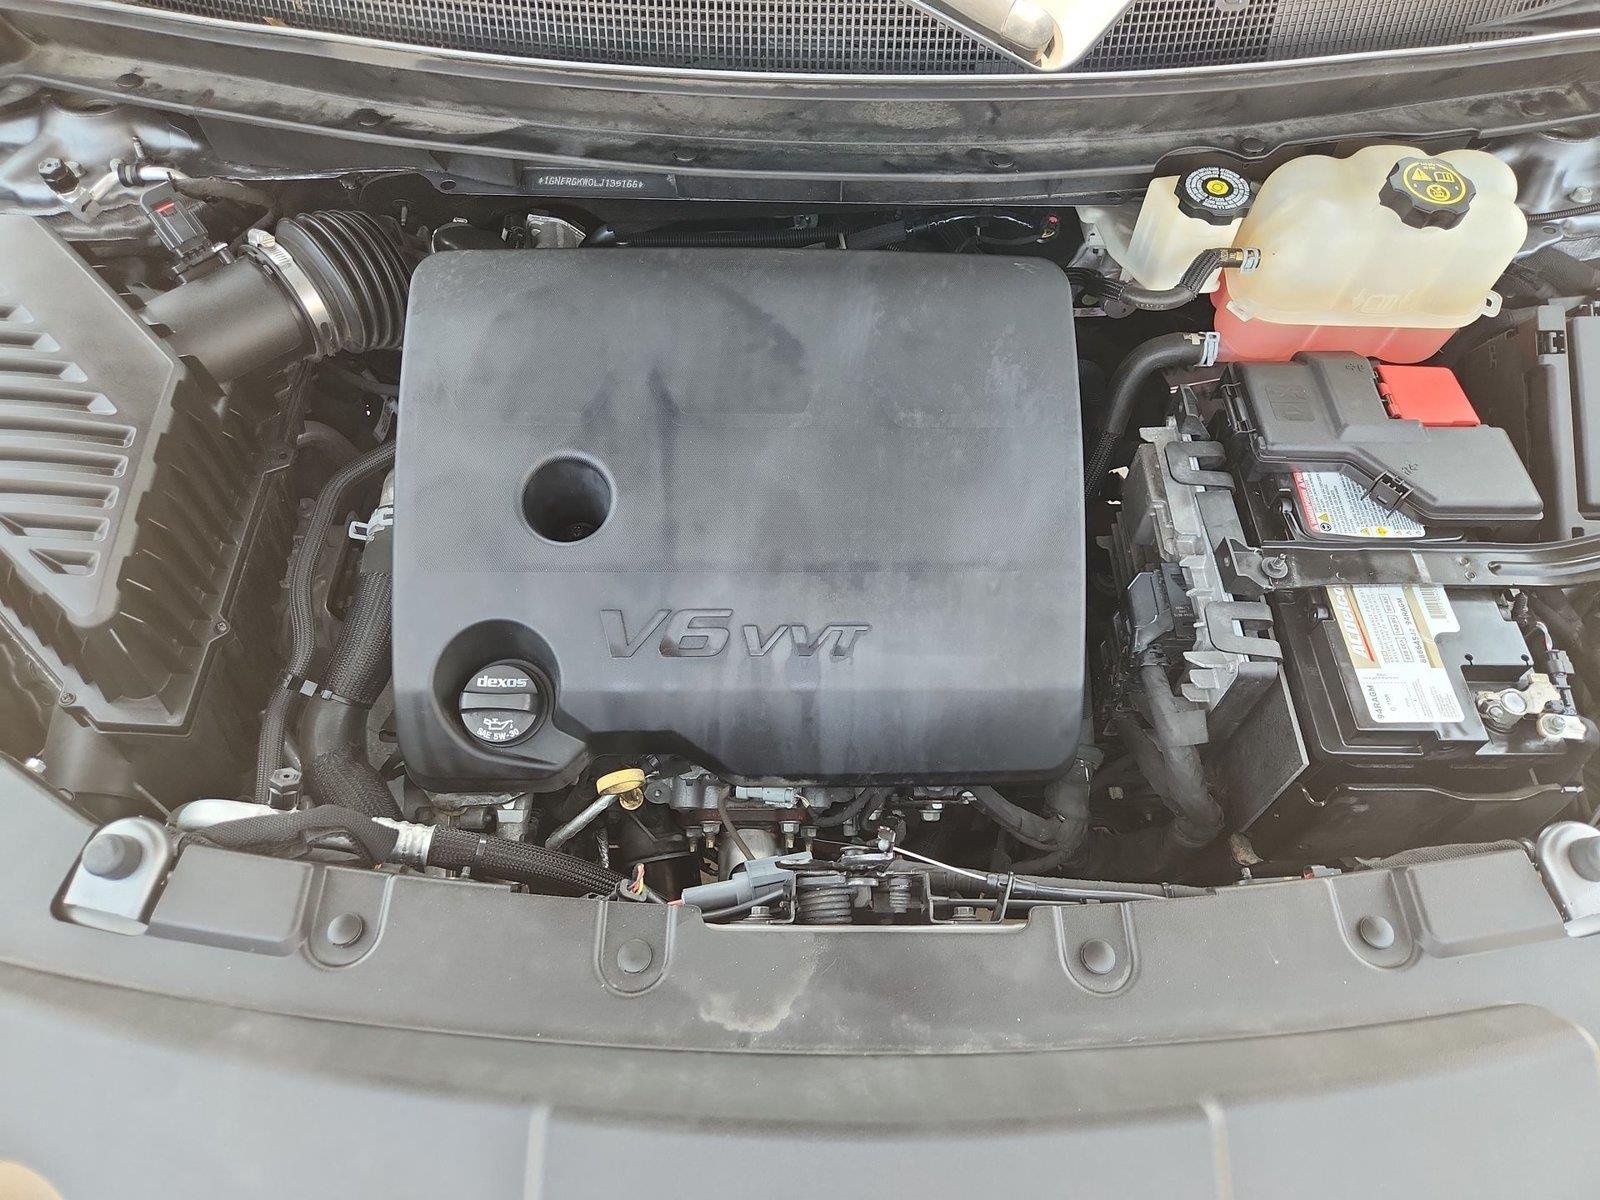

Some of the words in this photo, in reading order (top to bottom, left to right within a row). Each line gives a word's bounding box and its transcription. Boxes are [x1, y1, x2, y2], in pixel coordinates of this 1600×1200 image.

[600, 608, 734, 659] V6
[743, 624, 872, 657] VVT
[476, 675, 530, 688] dexos
[476, 727, 493, 739] SAE
[493, 728, 520, 740] 5W-30
